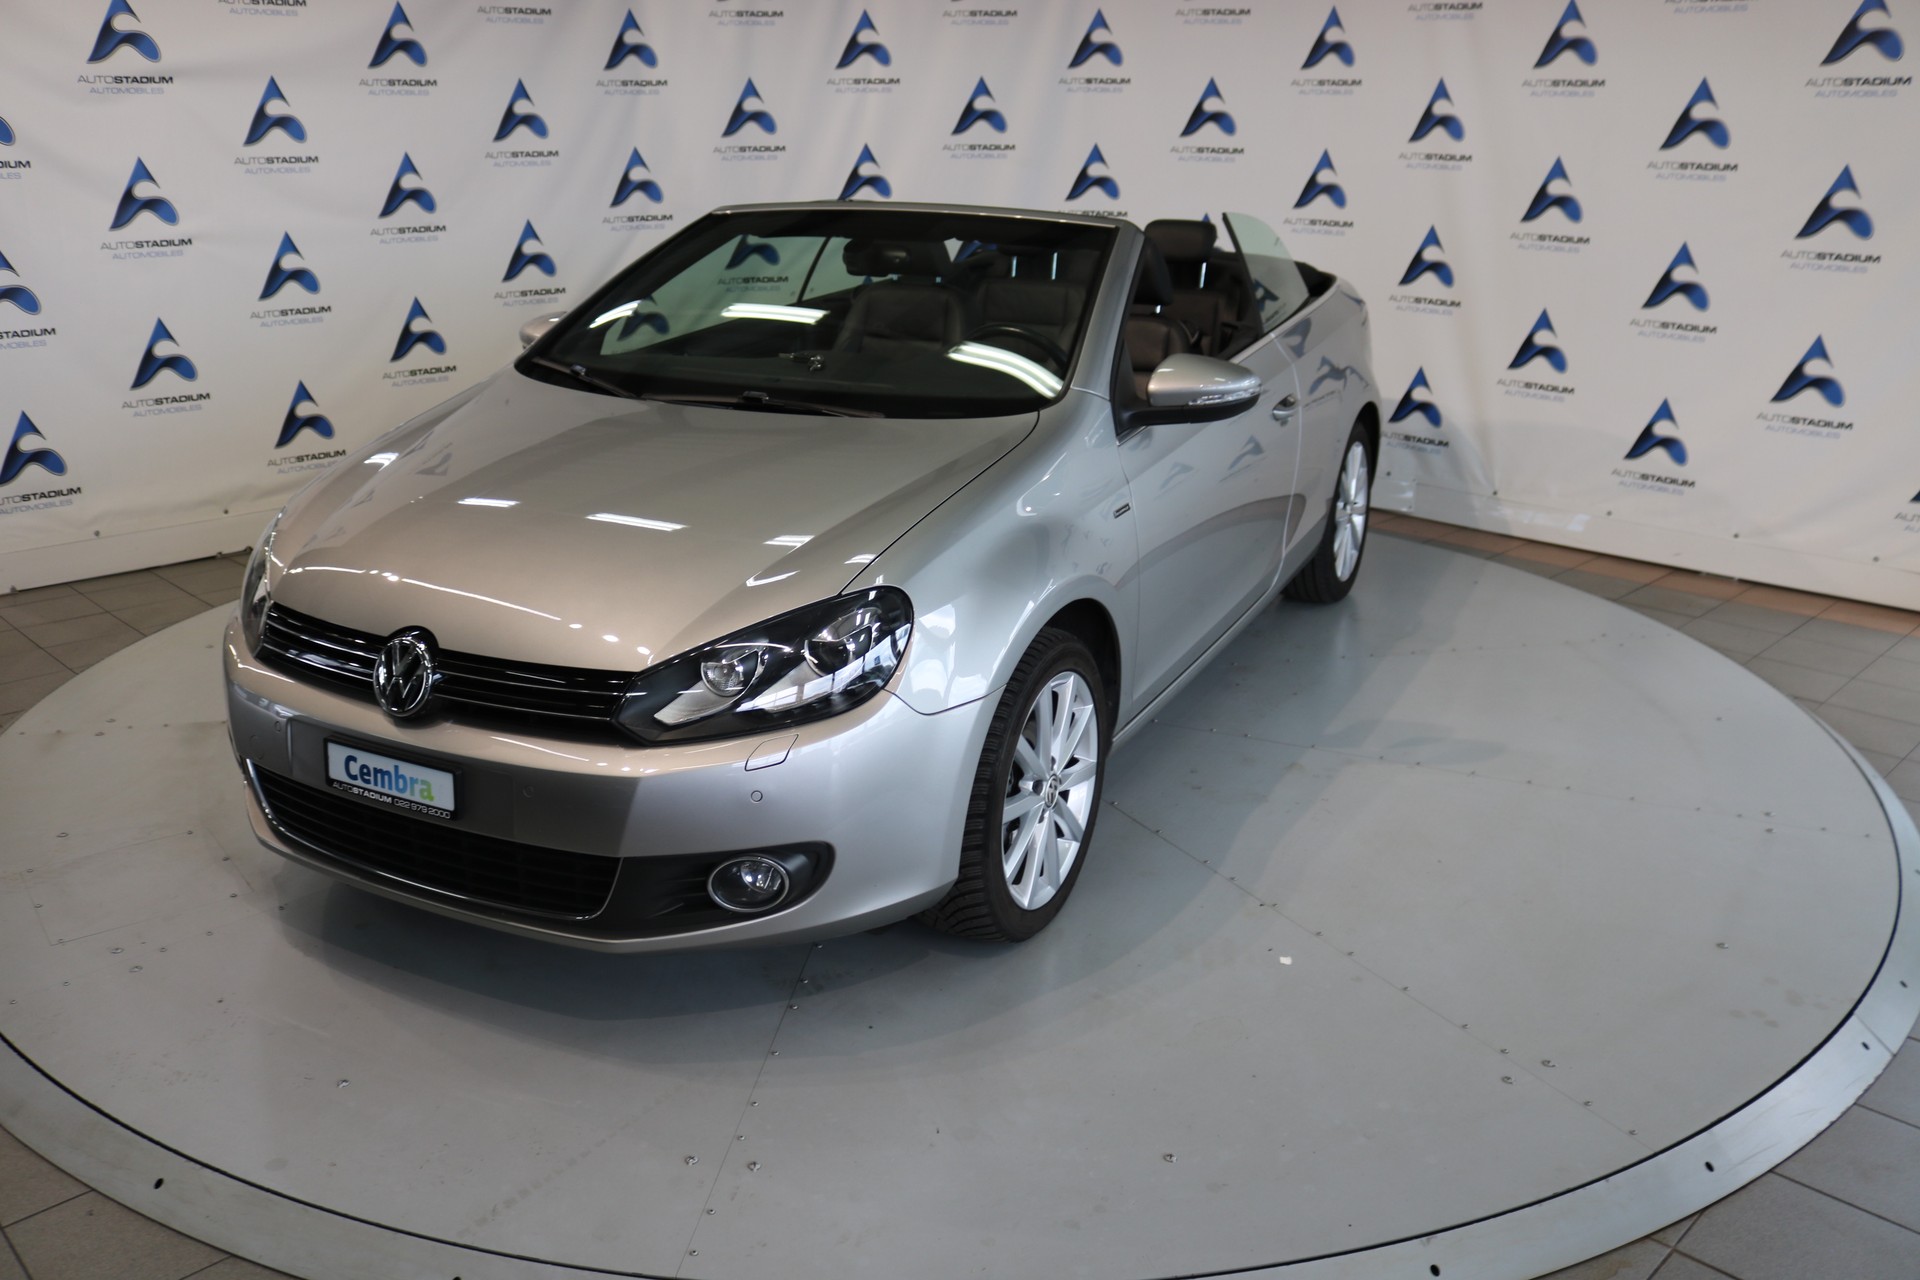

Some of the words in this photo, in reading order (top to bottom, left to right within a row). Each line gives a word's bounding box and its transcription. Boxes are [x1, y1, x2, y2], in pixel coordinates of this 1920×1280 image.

[478, 6, 552, 16] AUTOSTADIUM
[1408, 2, 1483, 11] AUTOSTADIUM
[709, 10, 784, 18] AUTOSTADIUM
[943, 9, 1017, 18] AUTOSTADIUM
[1176, 8, 1251, 17] AUTOSTADIUM
[77, 74, 174, 85] AUTOSTADIUM
[359, 78, 437, 88] AUTOSTADIUM
[596, 79, 668, 88] AUTOSTADIUM
[827, 77, 900, 86] AUTOSTADIUM
[1059, 77, 1131, 86] AUTOSTADIUM
[1291, 78, 1362, 87] AUTOSTADIUM
[1522, 78, 1605, 88] AUTOSTADIUM
[1805, 76, 1912, 88] AUTOSTADIUM
[714, 145, 786, 154] AUTOSTADIUM
[944, 143, 1016, 152] AUTOSTADIUM
[1171, 146, 1245, 155] AUTOSTADIUM
[485, 149, 559, 159] AUTOSTADIUM
[1399, 151, 1473, 162] AUTOSTADIUM
[234, 155, 318, 165] AUTOSTADIUM
[1647, 160, 1738, 172] AUTOSTADIUM
[602, 213, 673, 224] AUTOSTADIUM
[1284, 217, 1354, 229] AUTOSTADIUM
[370, 224, 446, 236] AUTOSTADIUM
[100, 237, 192, 251] AUTOSTADIUM
[1510, 232, 1590, 245] AUTOSTADIUM
[1781, 249, 1881, 264] AUTOSTADIUM
[494, 287, 566, 300] AUTOSTADIUM
[1389, 294, 1462, 308] AUTOSTADIUM
[250, 305, 332, 319] AUTOSTADIUM
[1630, 318, 1717, 334] AUTOSTADIUM
[383, 365, 457, 380] AUTOSTADIUM
[1497, 377, 1575, 395] AUTOSTADIUM
[122, 392, 211, 410] AUTOSTADIUM
[1756, 412, 1854, 431] AUTOSTADIUM
[267, 449, 346, 468] AUTOSTADIUM
[1611, 468, 1696, 488] AUTOSTADIUM
[344, 755, 435, 802] Cembra
[332, 781, 392, 804] AUTOSTADIUM
[393, 798, 411, 810] 022
[411, 802, 428, 814] 979
[428, 807, 451, 819] 2000
